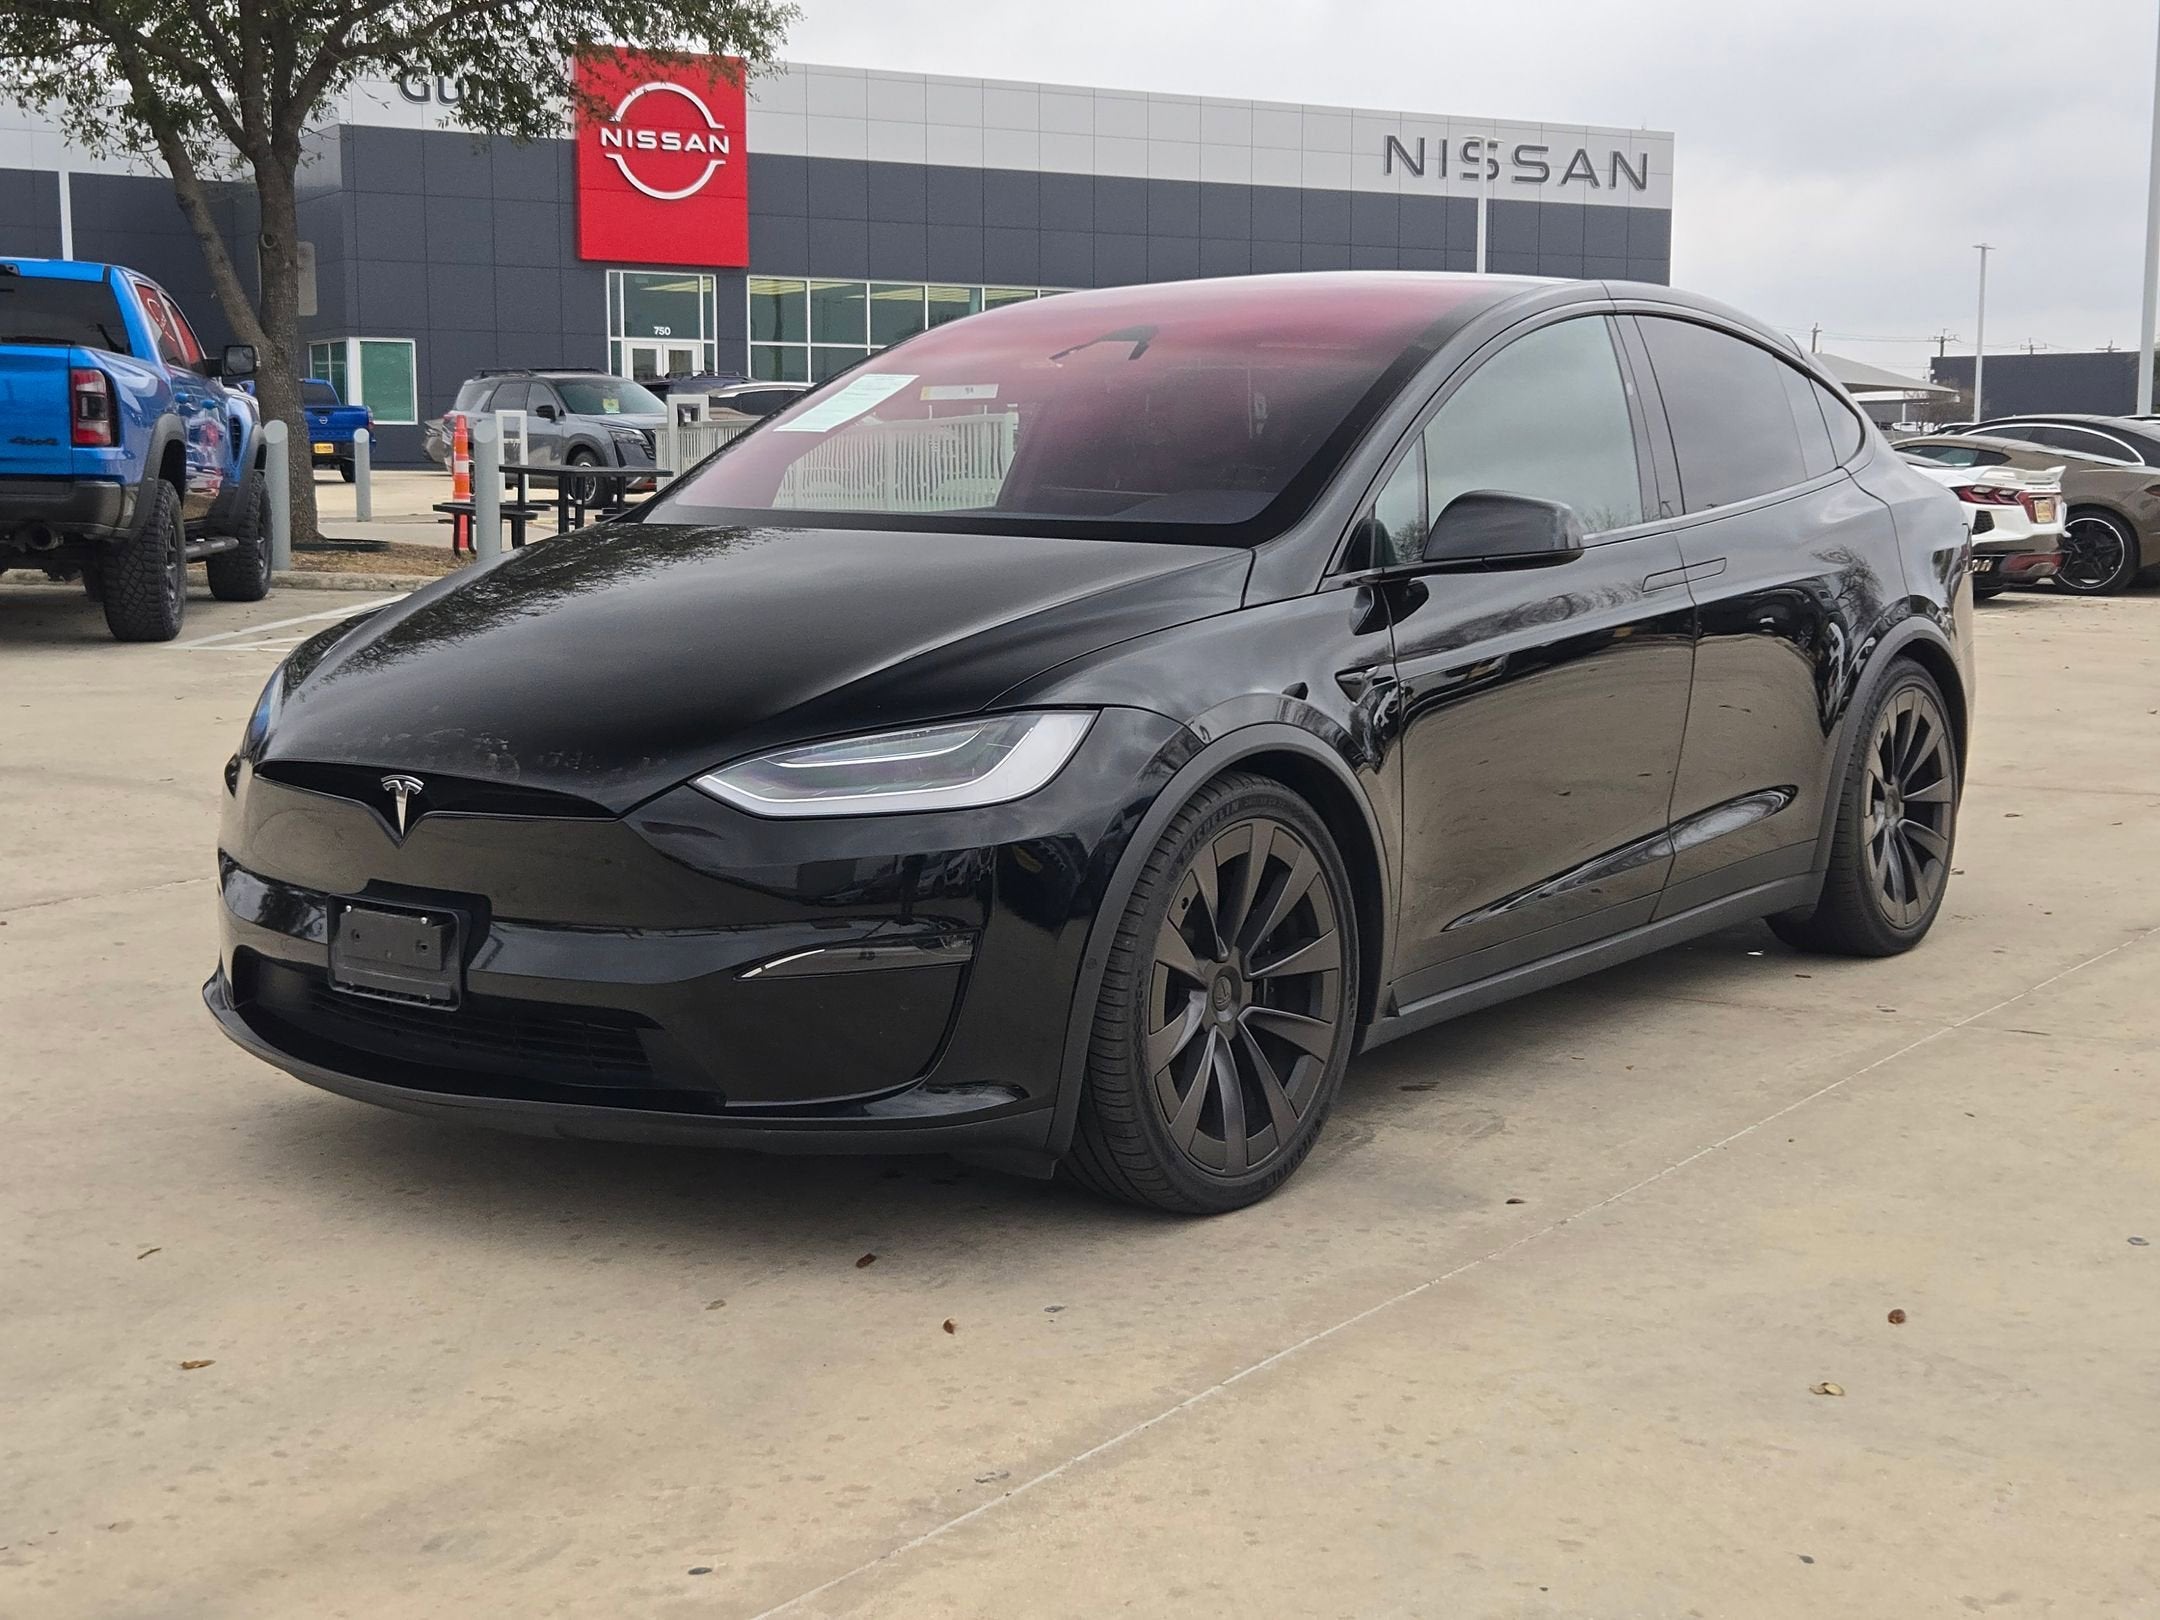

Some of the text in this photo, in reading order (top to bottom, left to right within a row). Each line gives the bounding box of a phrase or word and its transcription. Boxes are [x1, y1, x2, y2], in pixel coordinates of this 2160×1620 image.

[600, 127, 730, 154] NISSAN
[1383, 134, 1649, 191] NISSAN
[653, 326, 671, 336] 750
